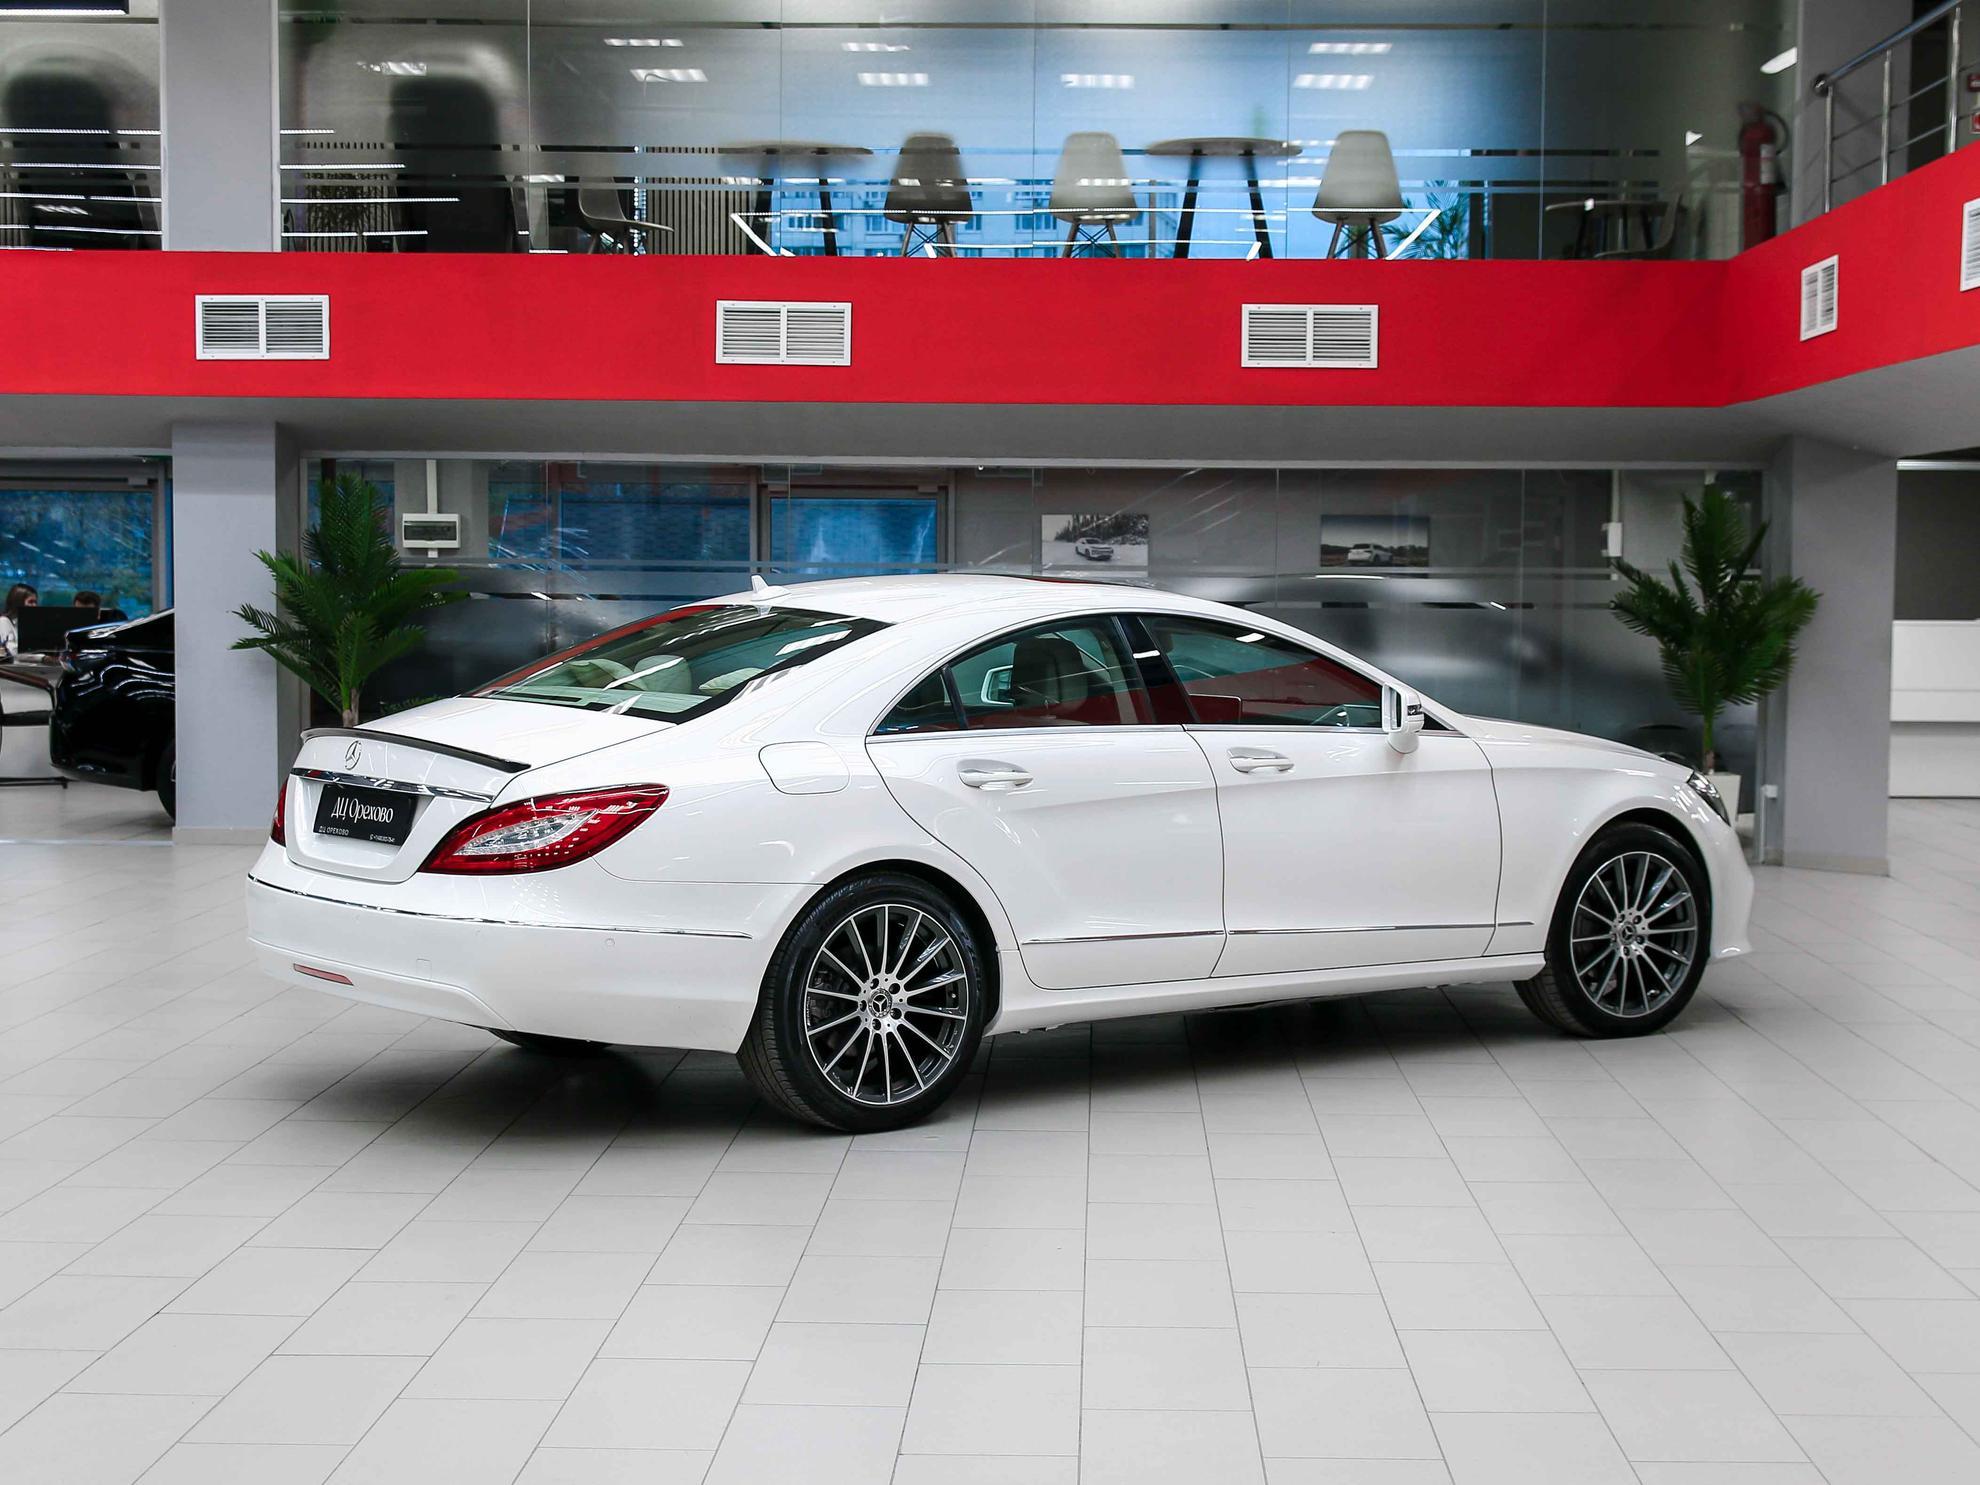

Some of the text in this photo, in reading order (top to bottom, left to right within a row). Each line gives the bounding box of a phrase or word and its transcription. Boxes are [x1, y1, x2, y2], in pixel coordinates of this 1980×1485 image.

[331, 797, 394, 823] ДЦ Орехово
[326, 827, 349, 836] ОРЕХОВО
